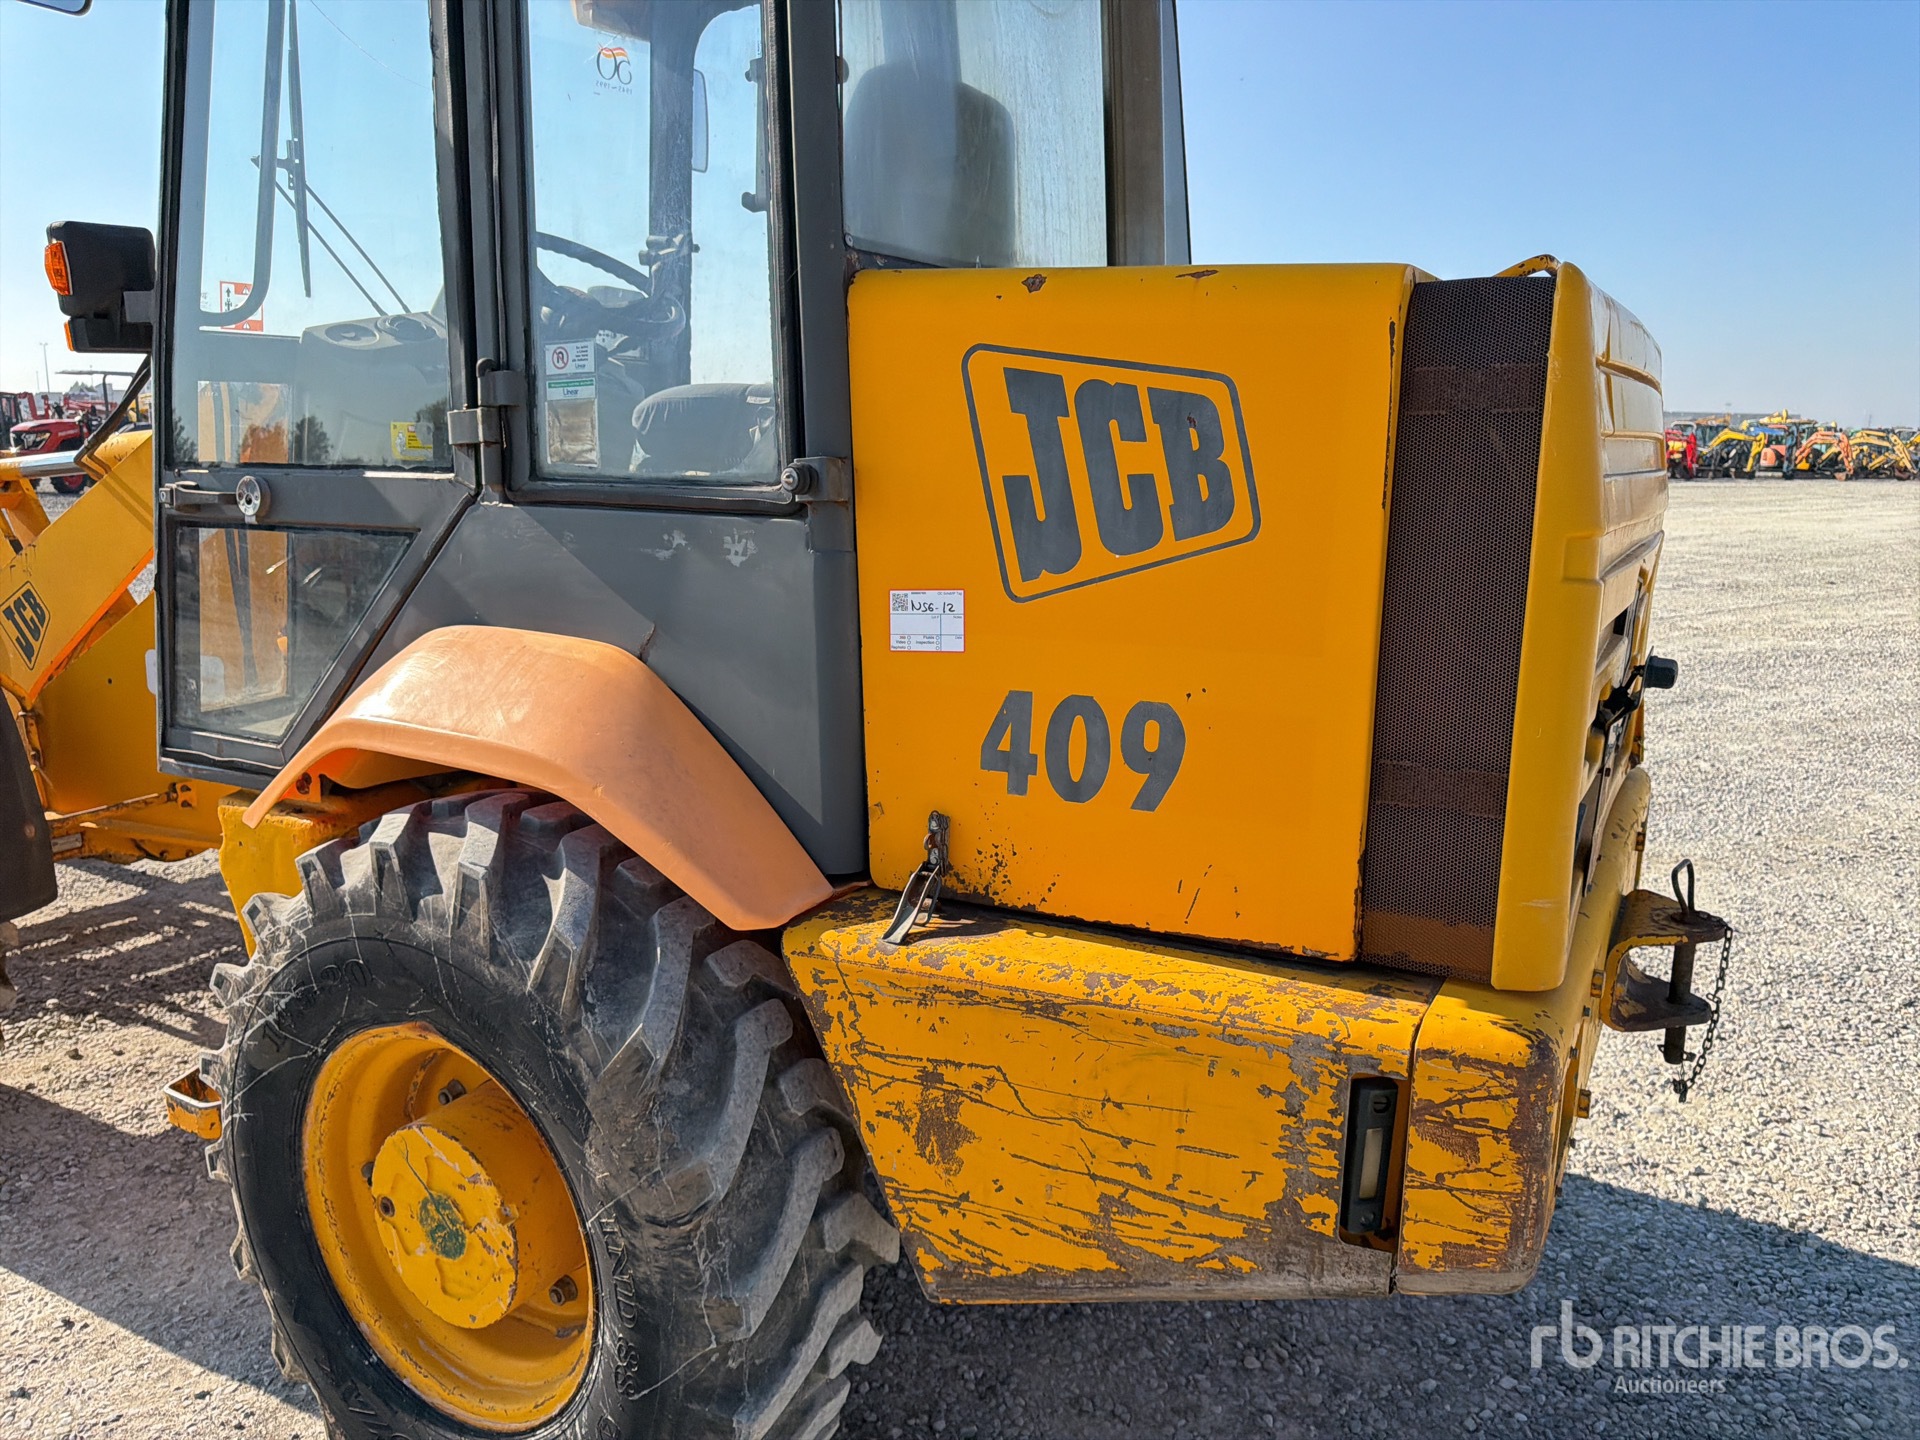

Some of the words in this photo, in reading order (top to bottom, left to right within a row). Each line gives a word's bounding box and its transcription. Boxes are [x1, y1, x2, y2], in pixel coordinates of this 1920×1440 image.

[1002, 366, 1236, 583] JCB
[2, 588, 46, 664] JCB
[980, 690, 1186, 812] 409
